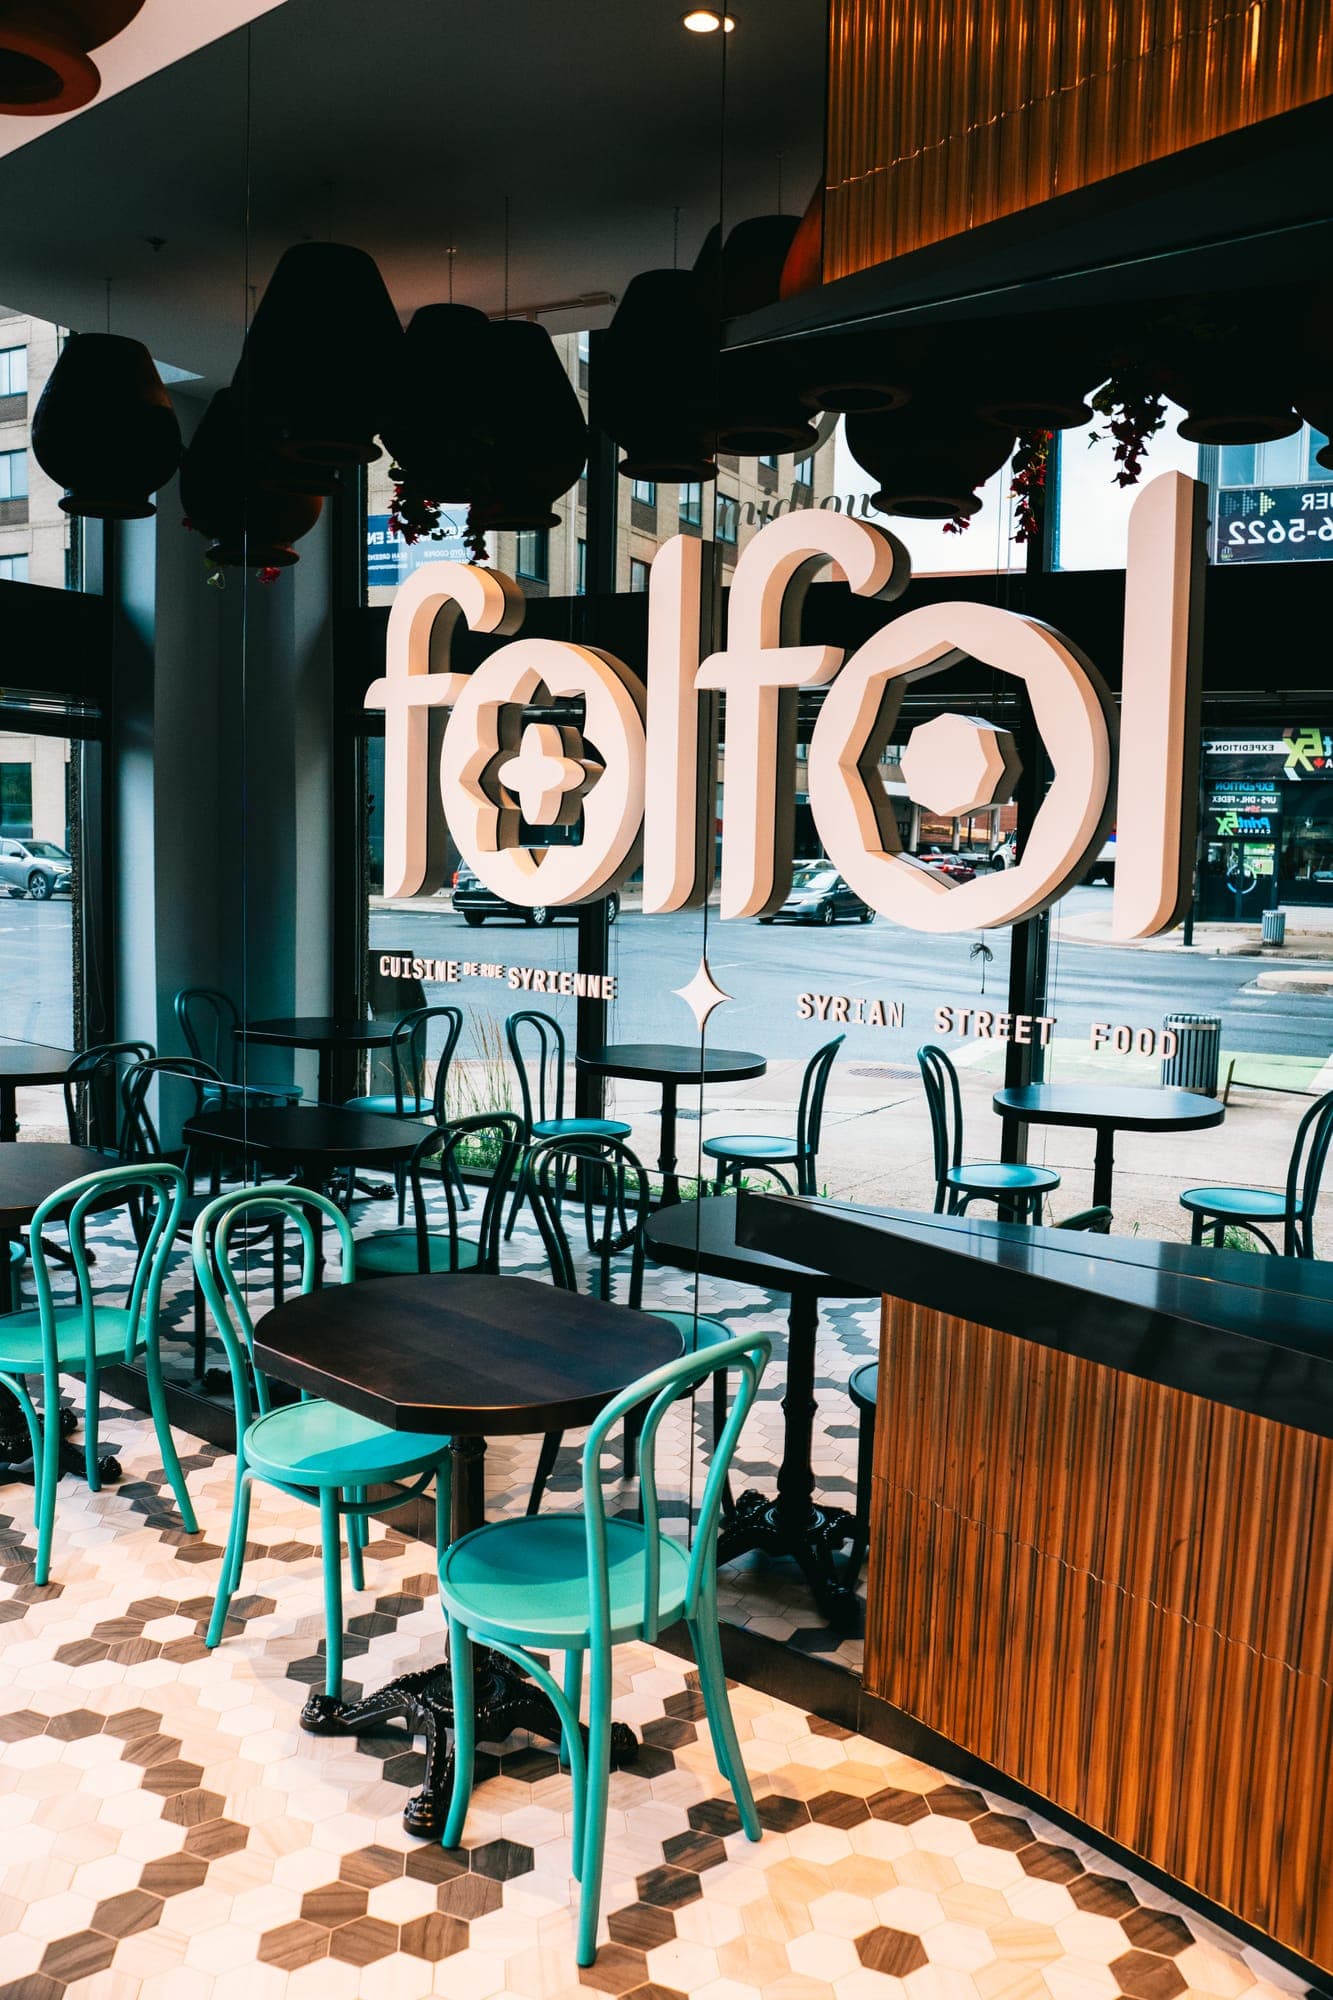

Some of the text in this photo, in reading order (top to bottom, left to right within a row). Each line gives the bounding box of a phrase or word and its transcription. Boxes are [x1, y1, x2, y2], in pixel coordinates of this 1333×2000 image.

[363, 470, 1207, 941] folfol
[380, 955, 618, 1000] CUISINE DE RUE SYRIENNE
[796, 993, 1179, 1060] SYRIAN STREET FOOD
